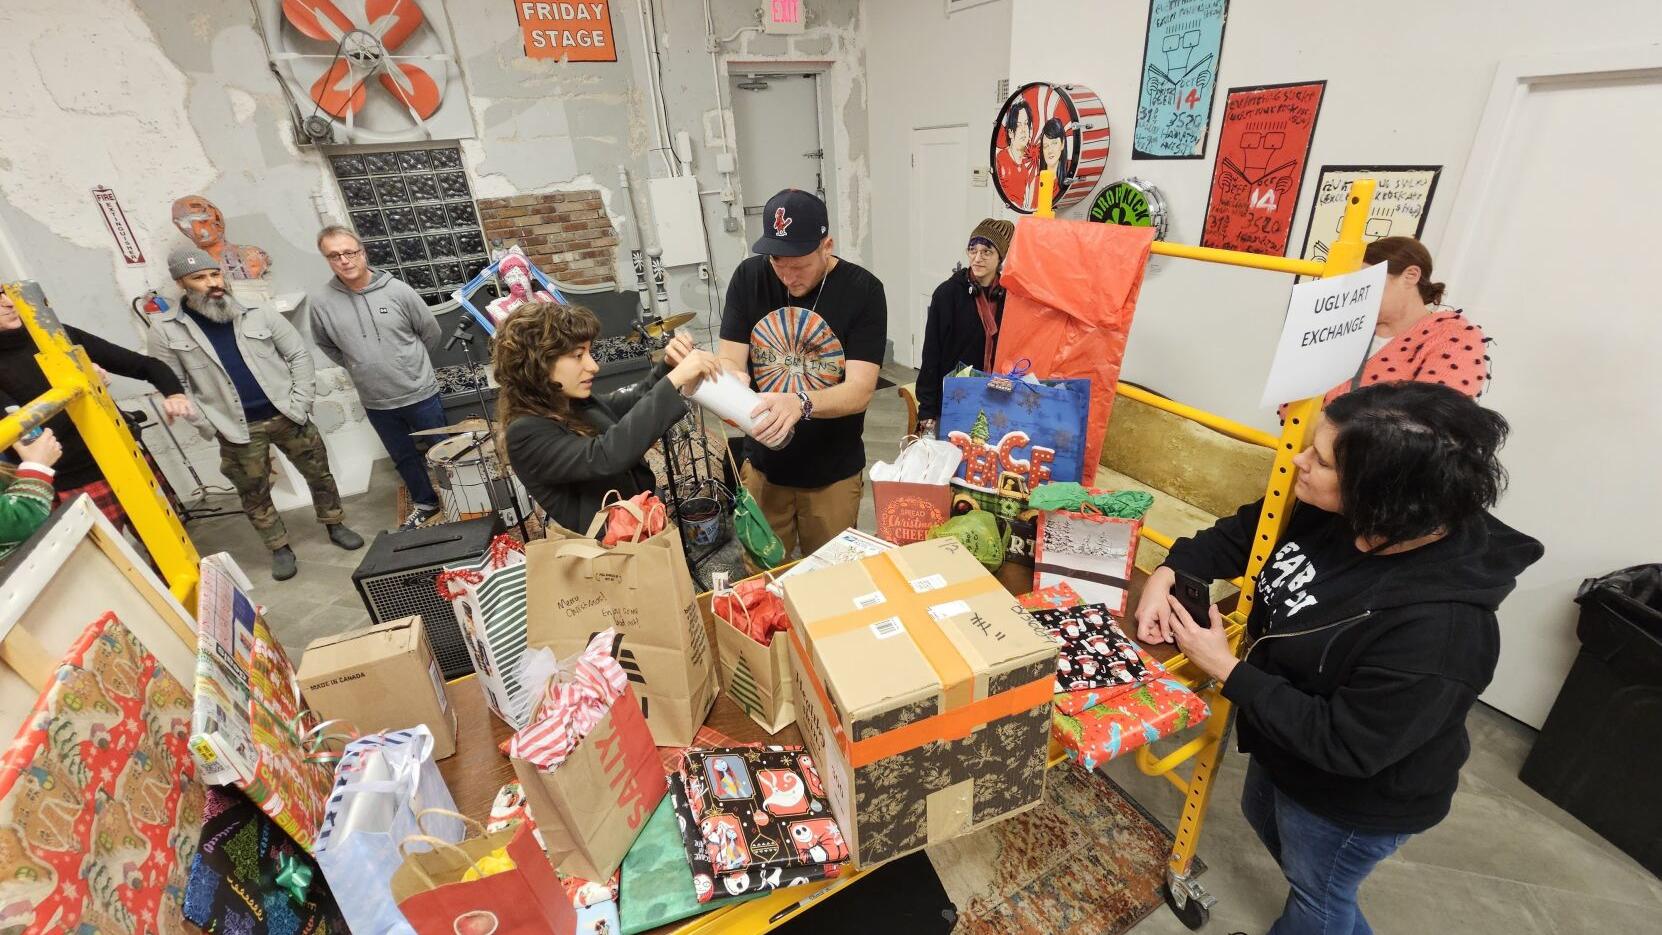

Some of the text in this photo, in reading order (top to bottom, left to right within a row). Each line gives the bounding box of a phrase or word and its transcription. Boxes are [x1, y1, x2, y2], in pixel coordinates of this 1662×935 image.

[521, 2, 604, 20] FRIDAY
[771, 0, 799, 22] EXIT
[531, 29, 606, 48] STAGE
[1176, 88, 1201, 111] 14
[96, 193, 115, 201] FIRE
[1092, 186, 1150, 222] DROPKICK
[1249, 188, 1277, 214] 14
[1314, 284, 1372, 314] UGLY ART
[1301, 314, 1366, 347] EXCHANGE
[310, 671, 367, 691] MADE IN CANADA
